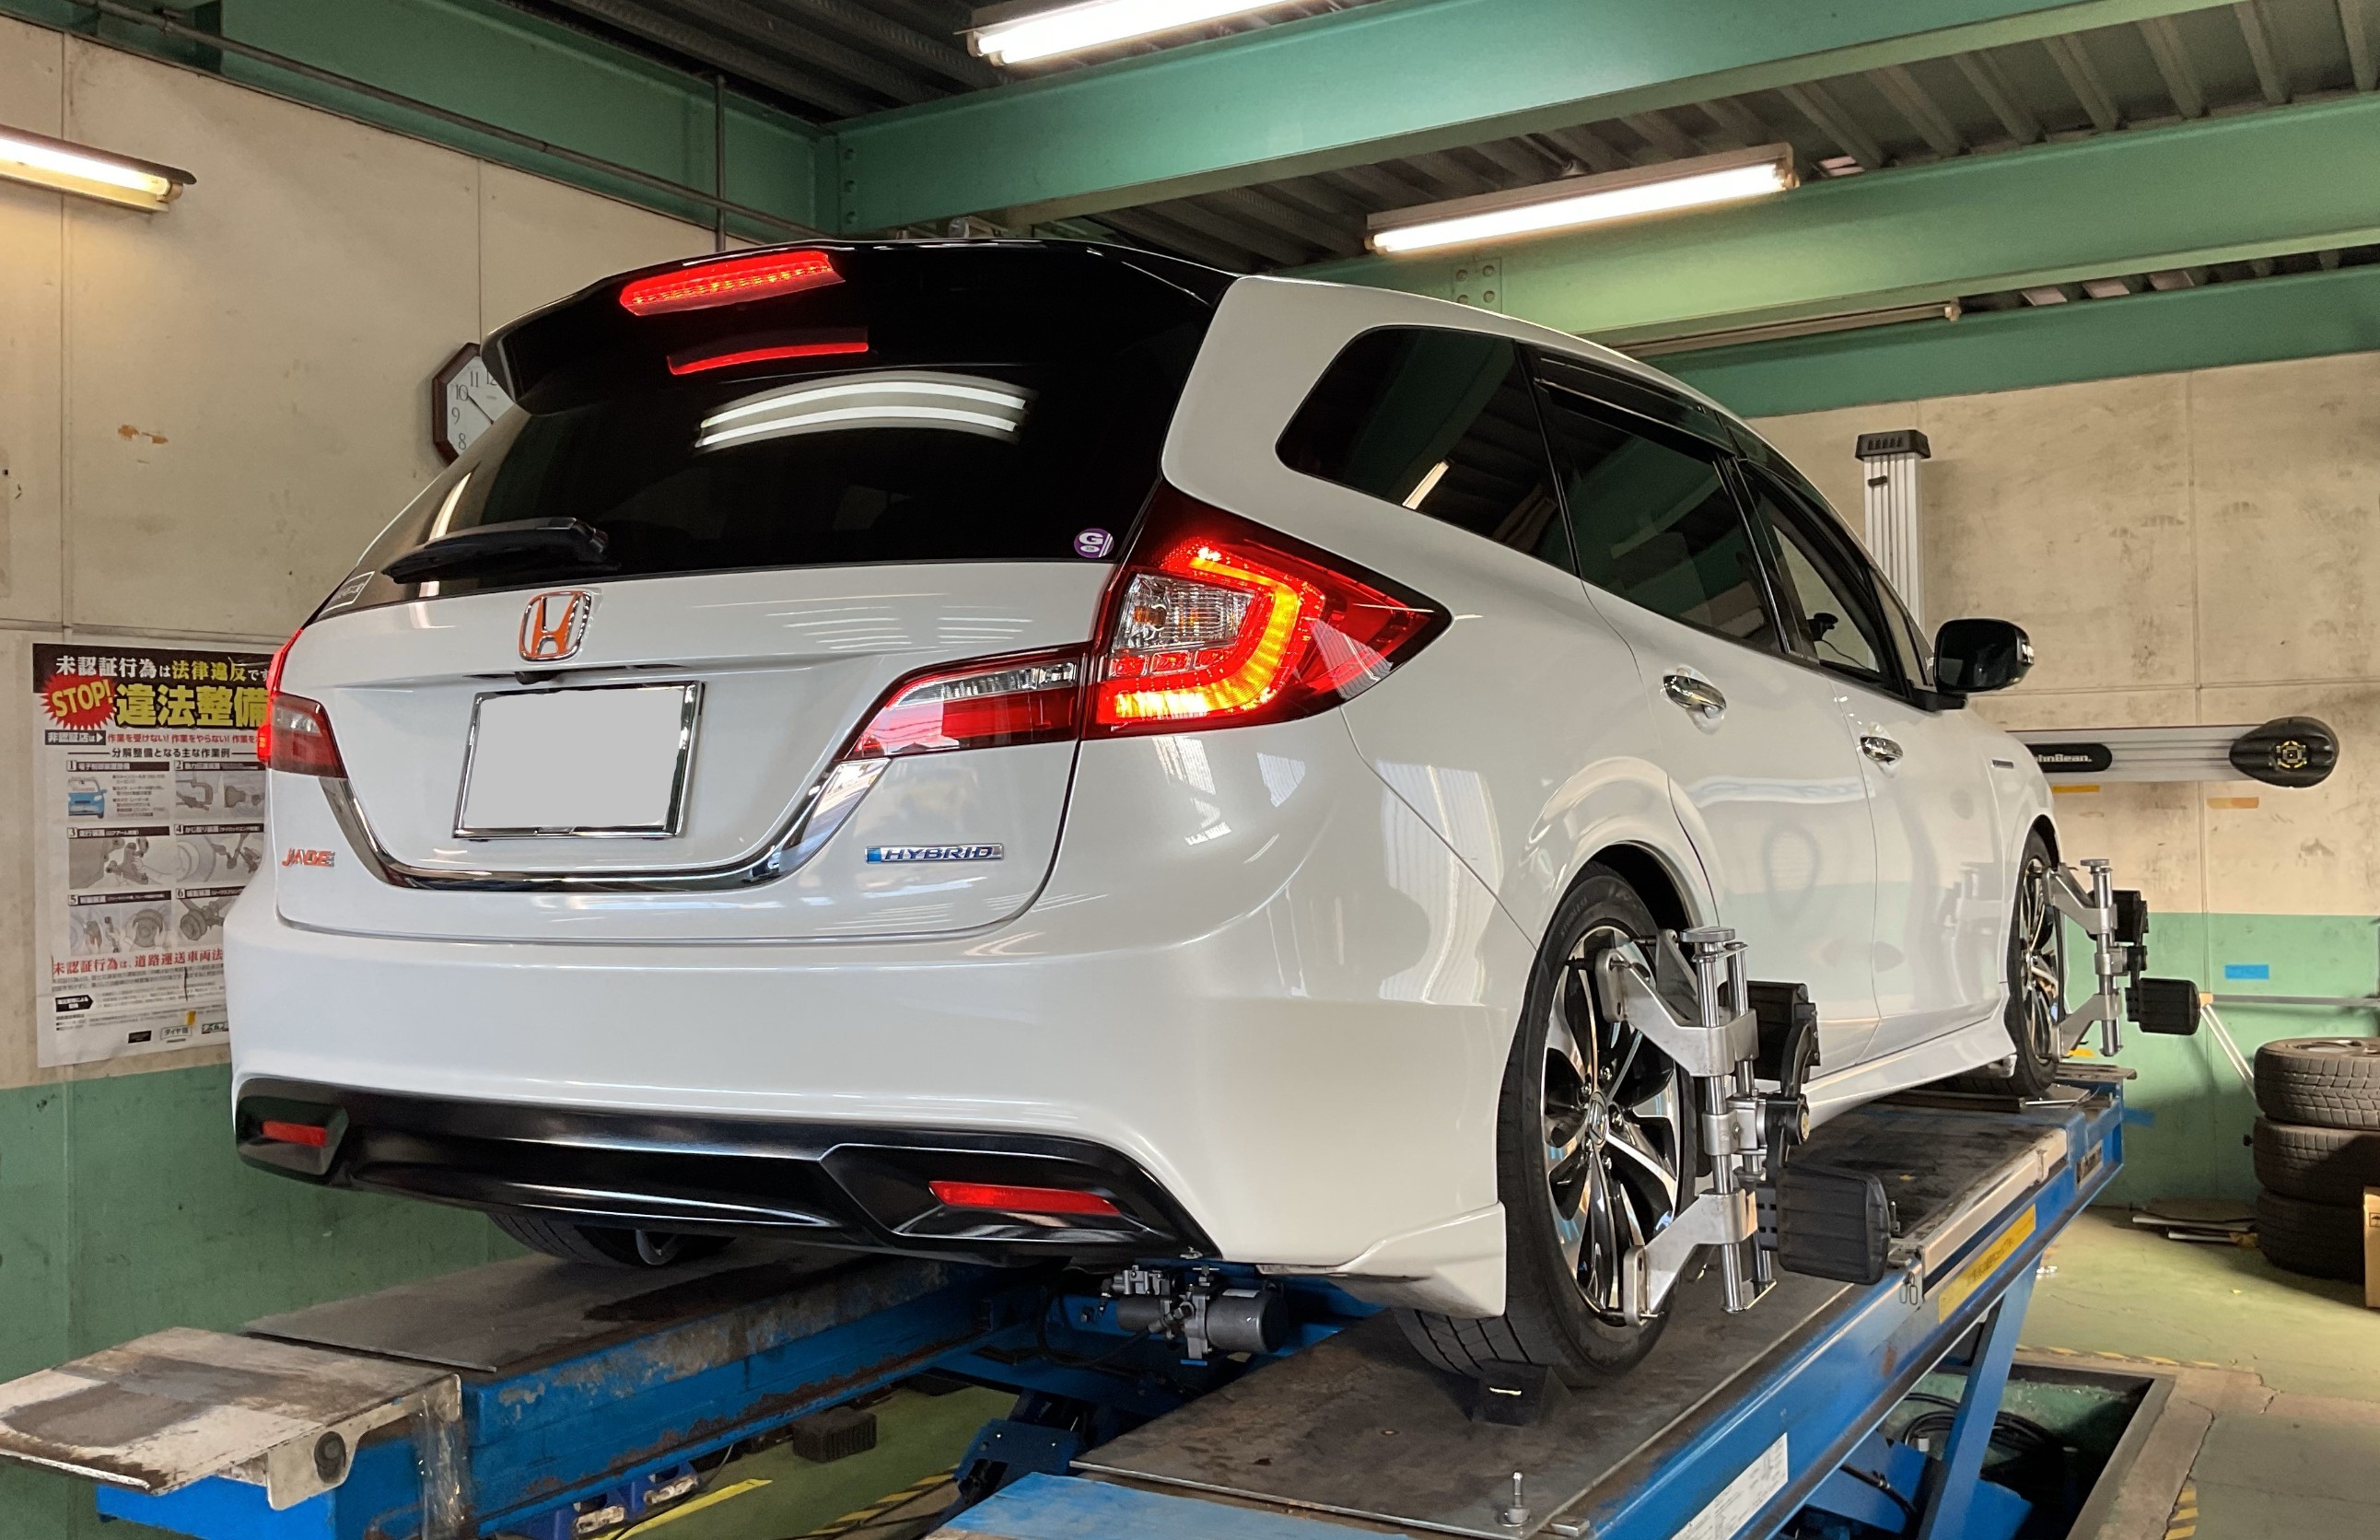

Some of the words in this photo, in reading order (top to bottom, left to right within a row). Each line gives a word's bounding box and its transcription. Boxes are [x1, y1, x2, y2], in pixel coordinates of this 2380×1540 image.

[455, 384, 469, 402] 10
[451, 407, 461, 426] 9
[458, 432, 467, 450] 8
[52, 679, 113, 718] STOP!
[111, 748, 230, 758] 分解整備となる主な作業例
[281, 847, 336, 868] JADE
[884, 846, 994, 860] HYBRID
